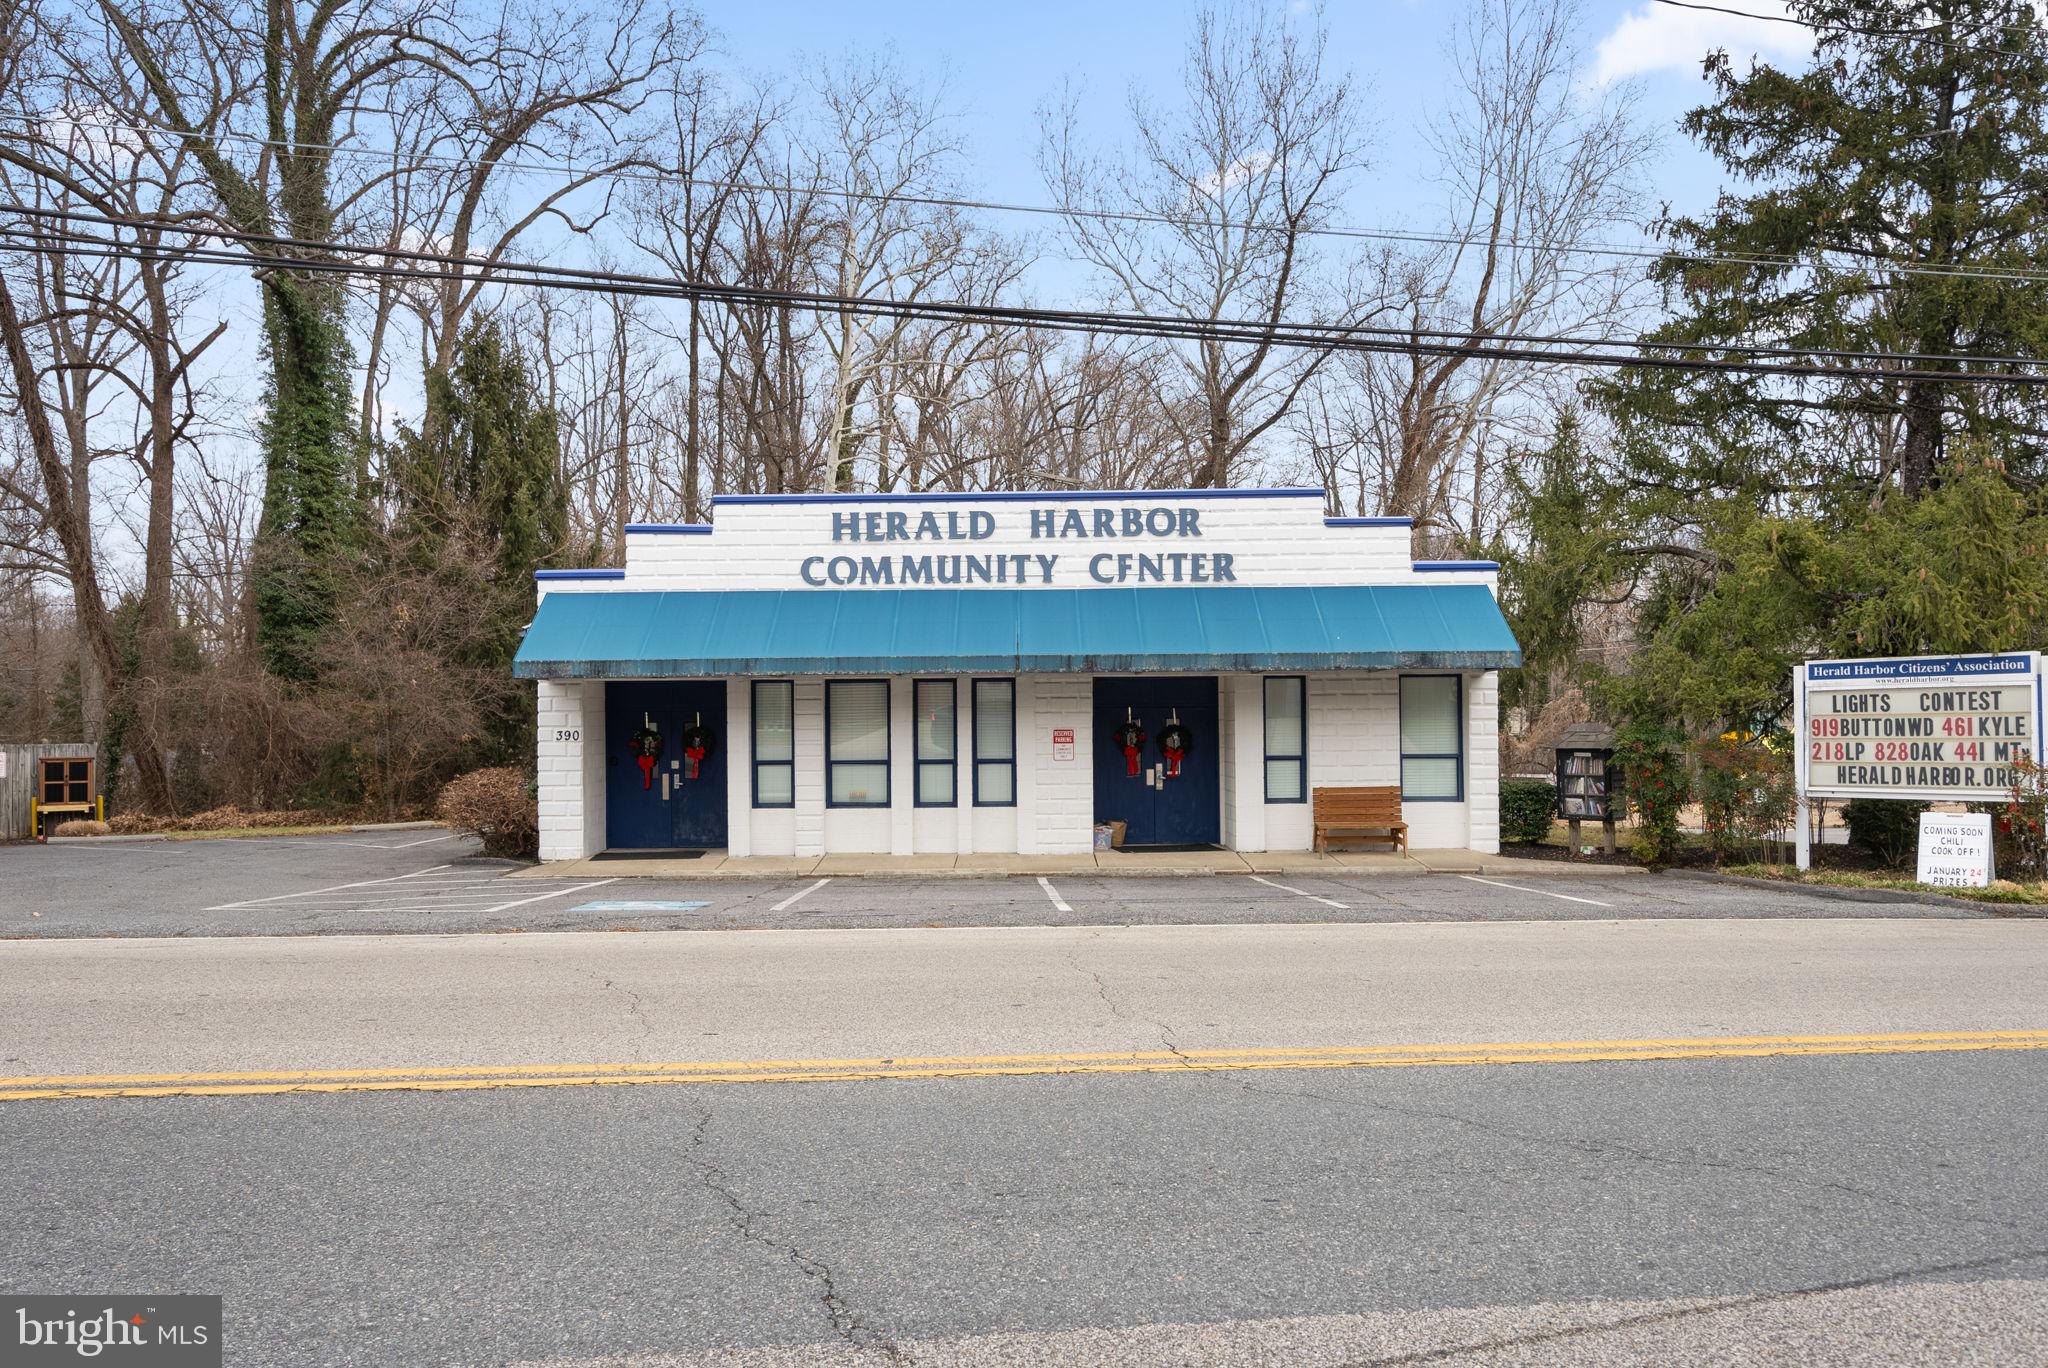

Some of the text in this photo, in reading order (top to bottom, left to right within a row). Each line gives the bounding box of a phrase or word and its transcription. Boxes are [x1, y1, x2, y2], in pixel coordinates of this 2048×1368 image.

[831, 507, 1203, 541] HERALD HARBOR
[800, 554, 1059, 586] COMMUNITY
[1813, 665, 1851, 677] Herald
[1854, 663, 1896, 675] Harbor
[1954, 660, 2025, 672] Association
[1875, 676, 1954, 684] www.heraldharbor.org
[1832, 691, 2002, 713] LIGHTS CONTEST
[1942, 717, 1973, 737] 461
[1978, 716, 2026, 736] KYLE
[556, 730, 580, 741] 390
[1924, 826, 1983, 836] COMING SOON
[1940, 837, 1963, 846] CHILI
[1931, 847, 1953, 855] COOK
[1927, 866, 1982, 877] JANUARY 24
[1933, 877, 1968, 887] PRIZES
